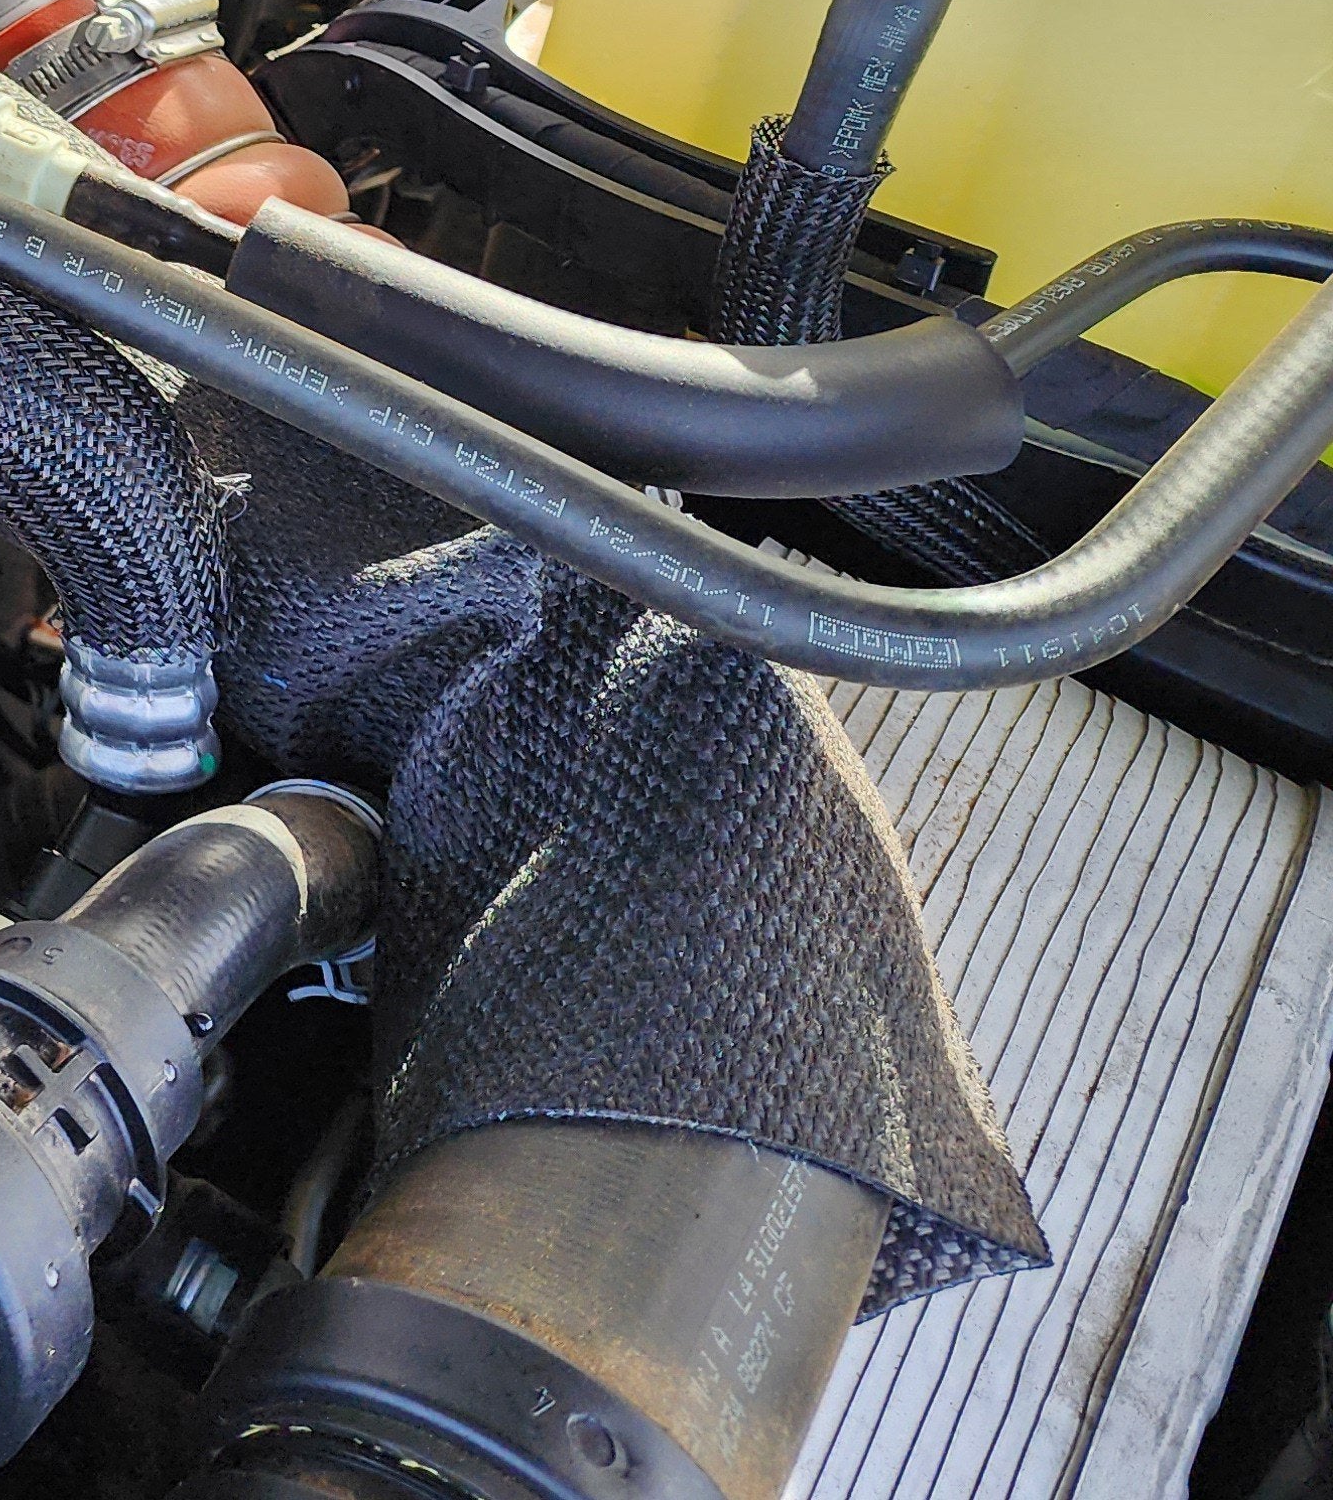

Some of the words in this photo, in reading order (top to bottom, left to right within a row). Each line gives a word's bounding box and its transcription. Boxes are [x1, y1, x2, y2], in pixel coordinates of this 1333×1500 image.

[858, 55, 896, 93] MEX
[23, 234, 47, 259] B
[140, 287, 207, 335] MEX
[225, 329, 350, 407] >EPDM<
[368, 405, 435, 448] CIP
[588, 515, 776, 628] 11/05/24
[810, 611, 961, 669] FoMoCo
